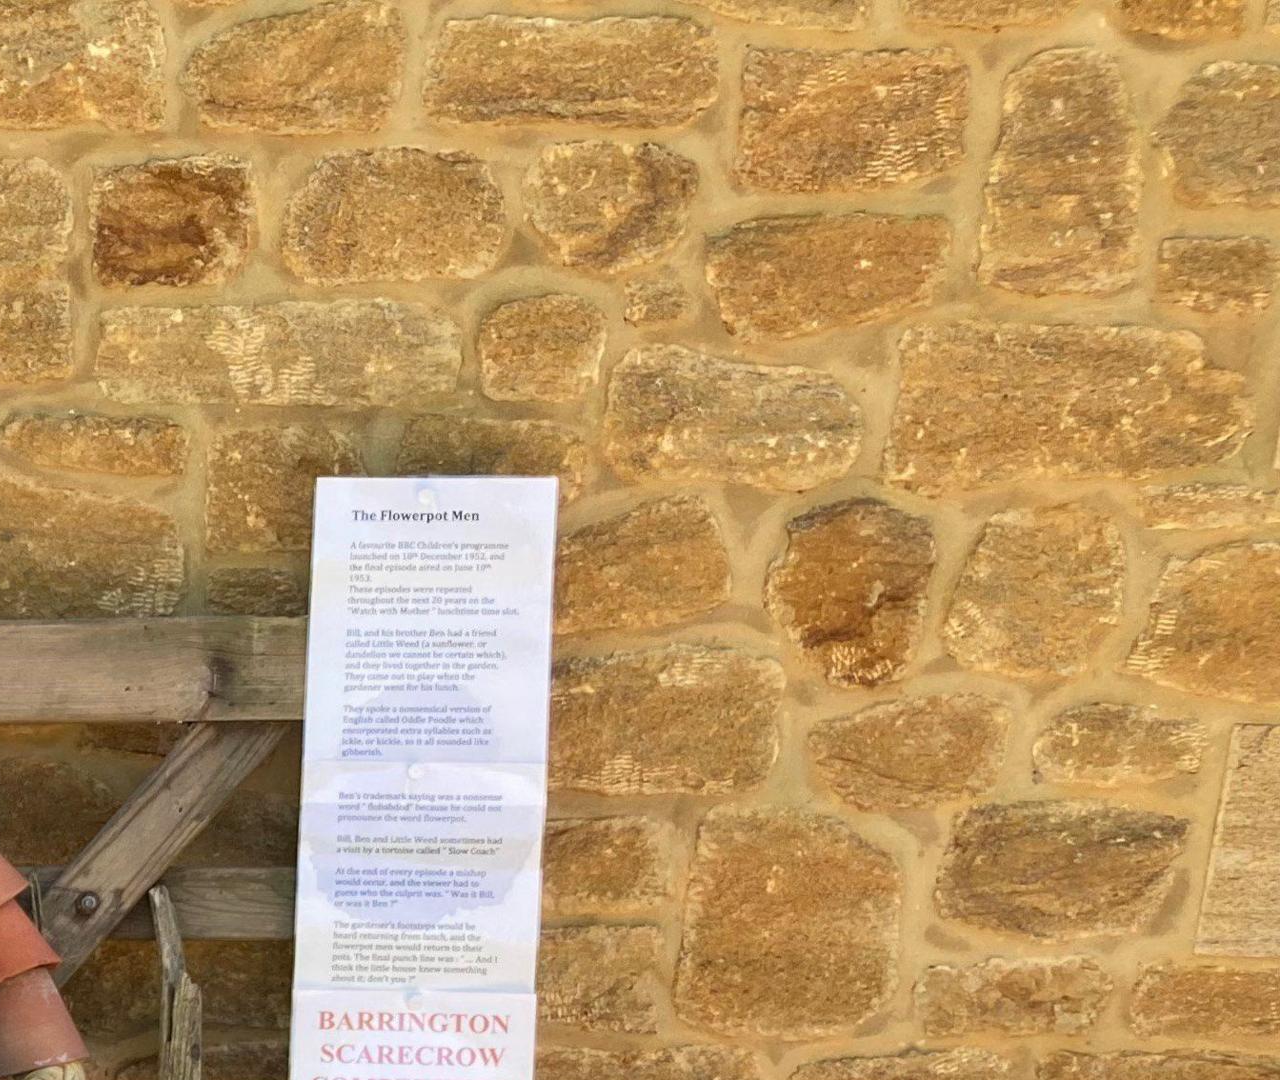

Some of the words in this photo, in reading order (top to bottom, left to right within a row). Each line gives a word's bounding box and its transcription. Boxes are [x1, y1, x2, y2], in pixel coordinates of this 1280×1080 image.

[353, 510, 377, 521] The
[381, 511, 448, 523] Flowerpot
[452, 511, 480, 521] Men
[358, 541, 395, 549] favourite
[397, 541, 415, 549] BBC
[350, 552, 387, 560] launched
[420, 552, 462, 560] December
[489, 552, 504, 560] and
[349, 563, 362, 571] the
[364, 563, 383, 571] final
[384, 563, 416, 573] episode
[418, 563, 440, 571] aired
[348, 585, 372, 593] These
[374, 585, 411, 595] episodes
[435, 585, 472, 595] repeated
[348, 596, 394, 606] throughout
[395, 596, 409, 604] the
[480, 596, 494, 604] the
[379, 607, 398, 615] with
[399, 607, 430, 615] Mother
[437, 607, 479, 615] lunchtime
[345, 640, 370, 648] called
[371, 640, 394, 648] Little
[395, 640, 419, 648] Weed
[344, 672, 365, 682] They
[416, 672, 434, 682] play
[436, 672, 459, 680] when
[461, 672, 474, 680] the
[384, 814, 397, 822] the
[399, 814, 421, 822] word
[354, 835, 370, 843] Ben
[372, 835, 388, 843] and
[390, 835, 412, 843] Little
[486, 836, 502, 844] had
[415, 846, 440, 854] called
[447, 846, 468, 854] Slow
[335, 878, 361, 886] would
[389, 878, 405, 886] and
[407, 878, 421, 886] the
[452, 879, 468, 887] had
[334, 921, 349, 929] The
[396, 921, 436, 931] footsteps
[437, 922, 463, 930] would
[332, 942, 373, 952] flowerpot
[395, 943, 421, 951] would
[462, 944, 483, 952] their
[331, 963, 353, 971] think
[355, 963, 368, 972] the
[370, 964, 390, 972] little
[391, 964, 416, 972] house
[418, 964, 441, 972] knew
[443, 965, 487, 975] something
[318, 1010, 511, 1034] BARRINGTON
[320, 1043, 505, 1067] SCARECROW
